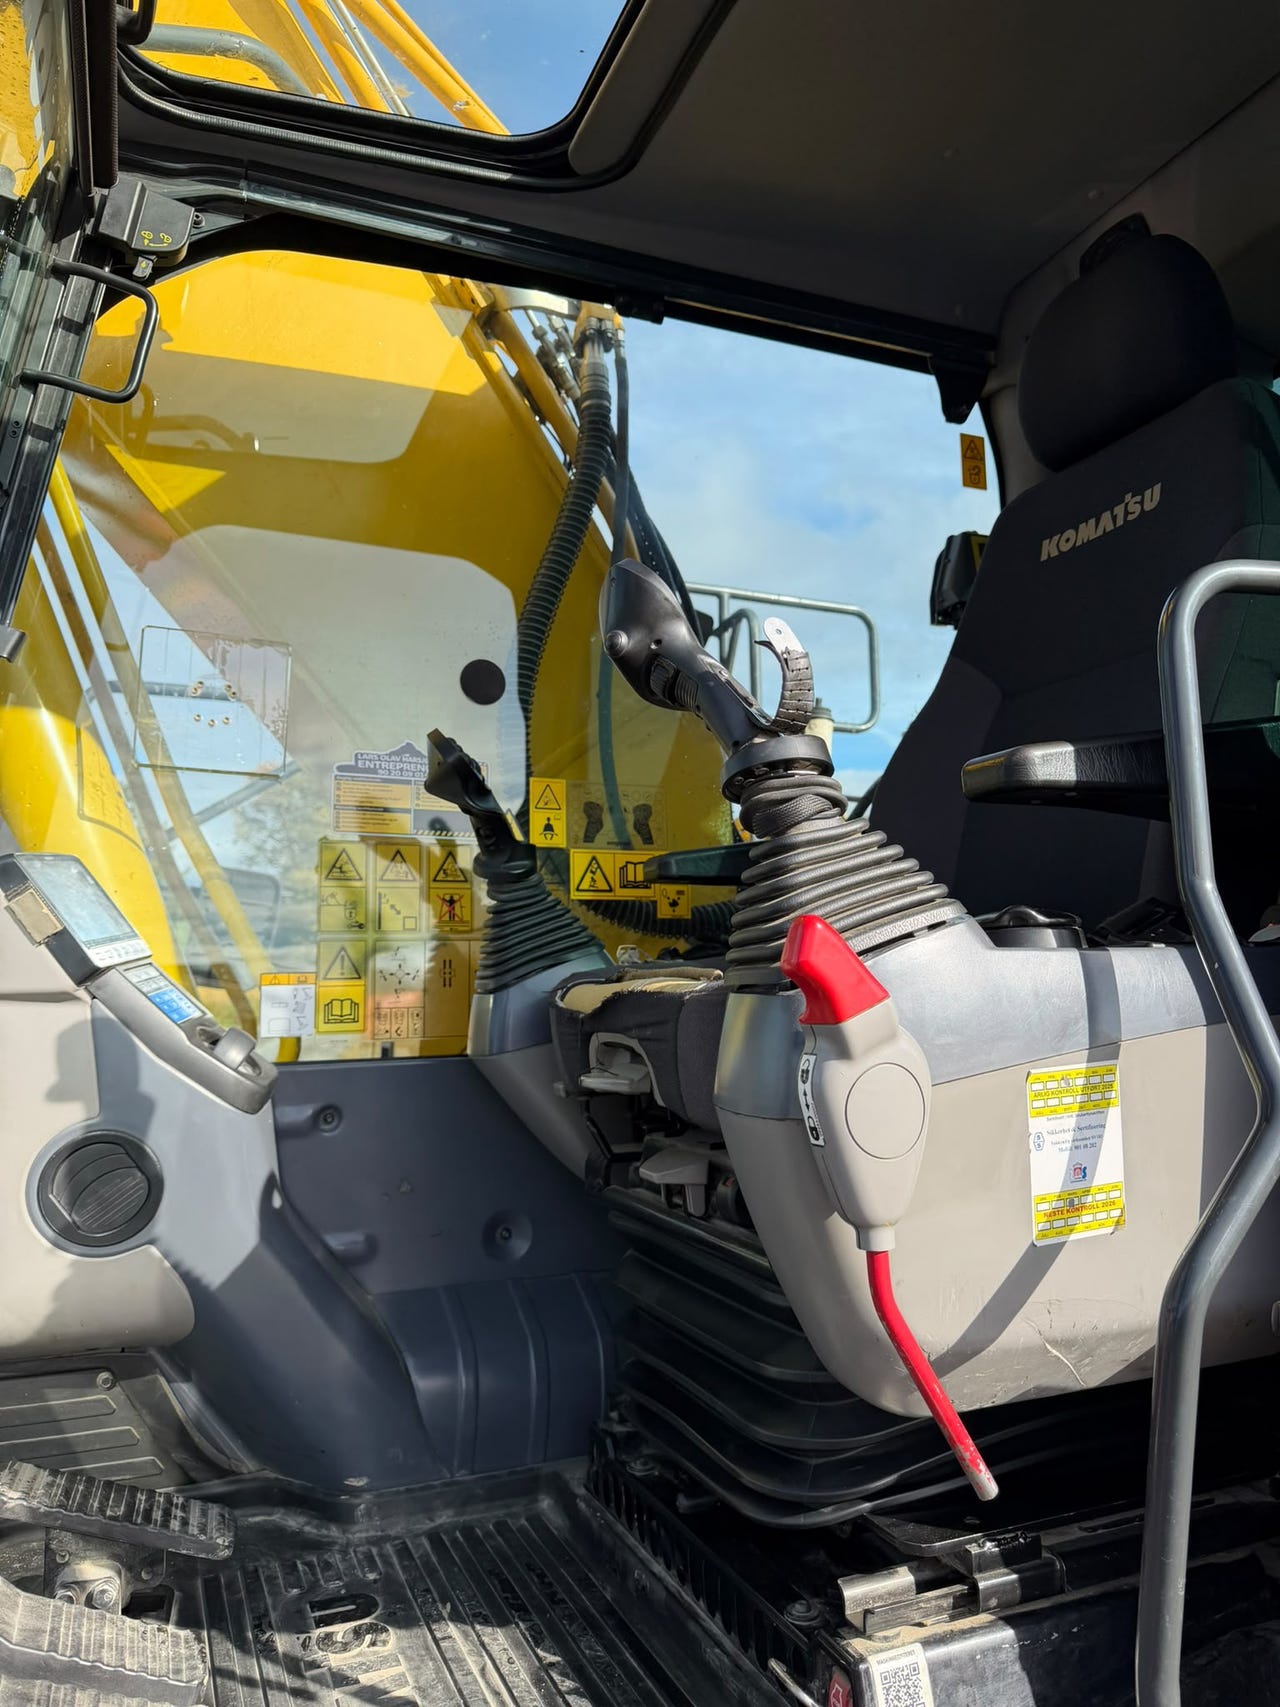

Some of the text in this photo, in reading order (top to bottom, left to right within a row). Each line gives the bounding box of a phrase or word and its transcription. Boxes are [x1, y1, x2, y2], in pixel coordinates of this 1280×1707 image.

[1040, 482, 1161, 562] KOMATSU
[1051, 1088, 1079, 1097] KONTROLL
[1043, 1200, 1116, 1219] NESTE KONTROLL 2026
